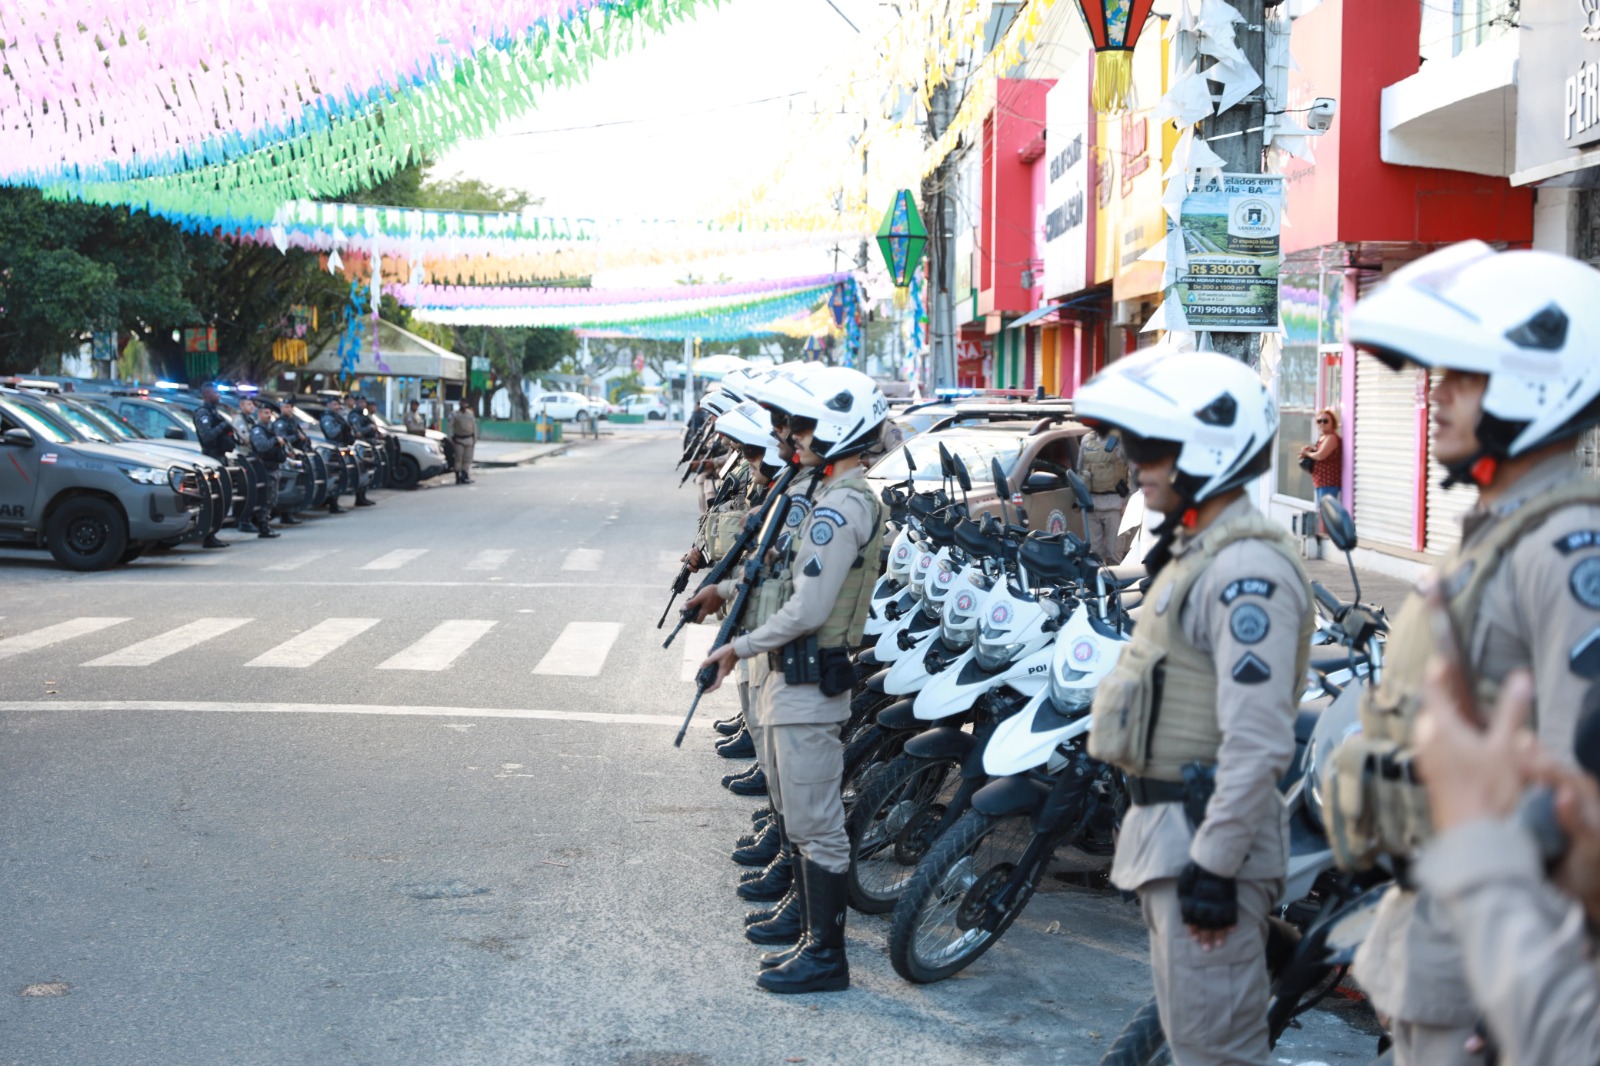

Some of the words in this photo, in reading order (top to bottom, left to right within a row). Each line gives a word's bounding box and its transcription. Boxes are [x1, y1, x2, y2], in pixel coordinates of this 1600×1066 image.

[1565, 60, 1600, 141] PÉR
[1258, 178, 1274, 186] em
[1248, 186, 1263, 194] BA
[1191, 264, 1207, 275] R$
[1209, 264, 1255, 276] 390,00
[1189, 305, 1204, 314] (71)
[1205, 306, 1256, 314] 99601-1048
[0, 504, 25, 517] AR
